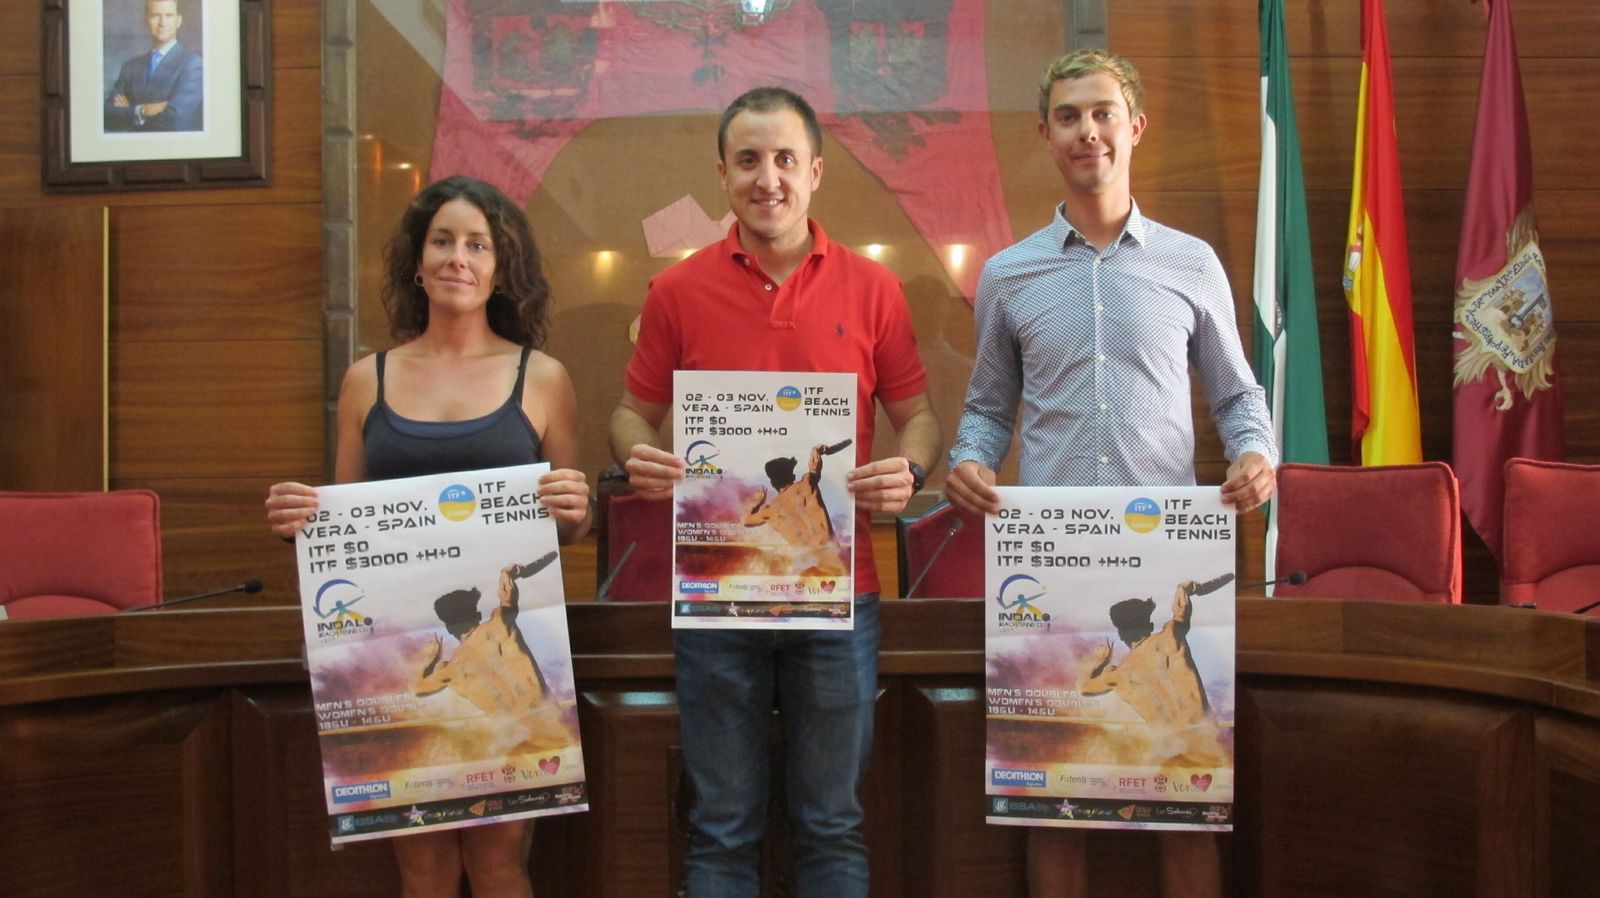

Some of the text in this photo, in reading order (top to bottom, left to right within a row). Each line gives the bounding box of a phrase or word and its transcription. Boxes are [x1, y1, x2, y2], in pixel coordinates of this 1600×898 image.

[804, 387, 824, 395] ITF
[685, 393, 703, 402] 02
[717, 393, 734, 402] 03
[738, 393, 769, 402] NOV.
[804, 397, 849, 406] BEACH
[681, 404, 720, 412] VERA
[733, 404, 774, 412] SPAIN
[804, 408, 851, 416] TENNIS
[685, 417, 704, 425] ITF
[685, 427, 704, 436] ITF
[709, 427, 752, 436] $3000
[478, 480, 506, 494] ITF
[350, 505, 376, 518] 03
[382, 500, 428, 515] NOV.
[1165, 499, 1192, 510] ITF
[481, 507, 550, 525] TENNIS
[998, 509, 1021, 519] 02
[1040, 509, 1064, 519] 03
[1071, 509, 1114, 519] NOV.
[1165, 514, 1227, 525] BEACH
[301, 523, 357, 539] VERA
[377, 514, 436, 532] SPAIN
[992, 523, 1045, 534] VERA
[1065, 524, 1120, 534] SPAIN
[1165, 529, 1231, 540] TENNIS
[308, 544, 336, 558] ITF
[997, 541, 1023, 552] ITF
[310, 560, 337, 574] ITF
[345, 552, 408, 570] $3000
[997, 555, 1023, 567] ITF
[1031, 555, 1091, 567] $3000
[770, 584, 791, 592] RFET
[466, 771, 495, 784] RFET
[994, 770, 1044, 781] DECATHLON
[1118, 777, 1146, 788] RFET
[335, 783, 388, 797] DECATHLON
